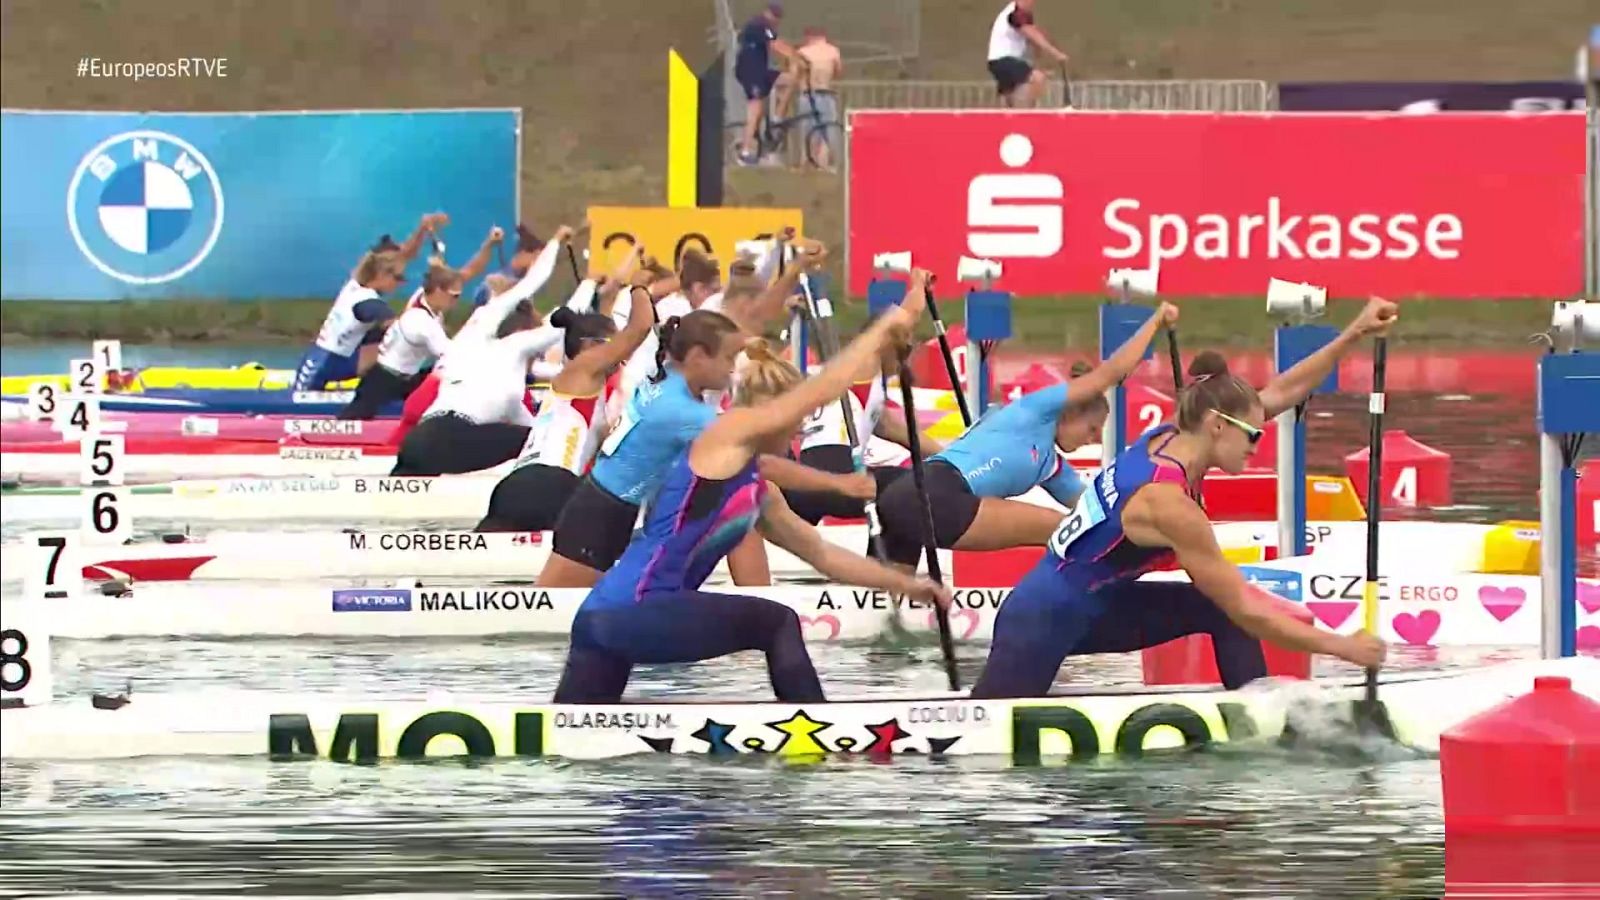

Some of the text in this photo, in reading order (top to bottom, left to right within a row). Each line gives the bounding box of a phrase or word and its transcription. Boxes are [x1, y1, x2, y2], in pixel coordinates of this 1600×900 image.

[90, 137, 202, 182] BMW
[1102, 196, 1464, 270] Sparkasse
[101, 346, 110, 367] 1
[79, 362, 95, 387] 2
[38, 385, 55, 414] 3
[70, 401, 90, 432] 4
[311, 420, 356, 433] KOCH
[91, 440, 114, 476] 5
[378, 479, 433, 493] NAGY
[1391, 466, 1417, 506] 4
[92, 491, 119, 534] 6
[350, 533, 488, 550] M. CORBERA
[1058, 514, 1082, 545] 8
[38, 537, 67, 585] 7
[420, 590, 554, 611] MALIKOVA
[816, 589, 842, 610] A.
[1309, 574, 1391, 601] CZE
[1400, 585, 1459, 601] ERGO
[1, 628, 32, 692] 8
